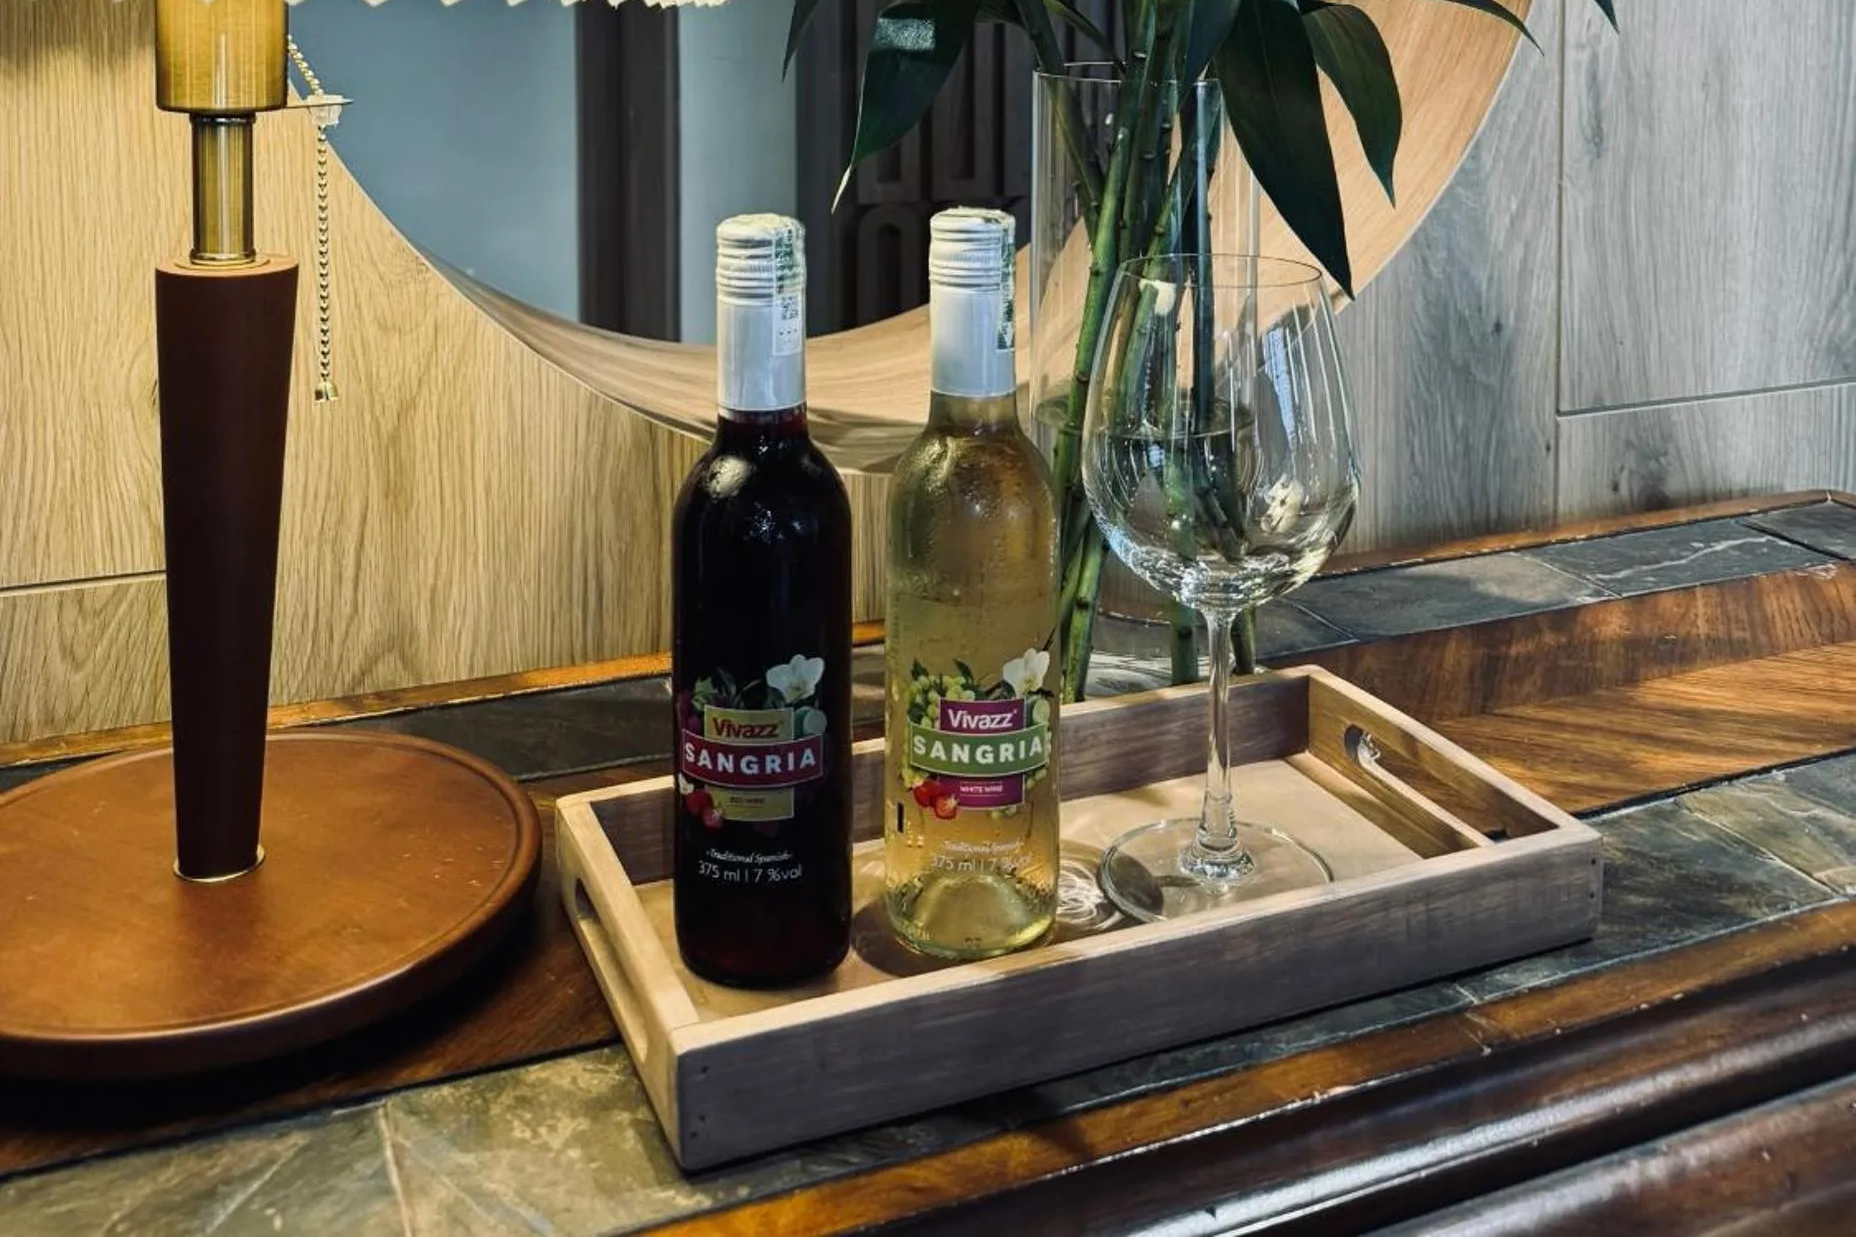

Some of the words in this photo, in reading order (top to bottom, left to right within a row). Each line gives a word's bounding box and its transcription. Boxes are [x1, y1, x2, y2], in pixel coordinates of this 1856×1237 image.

[713, 717, 779, 739] Vivazz
[948, 709, 1014, 731] Vivazz
[685, 742, 816, 774] SANGRIA
[913, 735, 1043, 765] SANGRIA
[699, 860, 720, 878] 375
[724, 868, 741, 882] ml
[753, 868, 763, 883] 7
